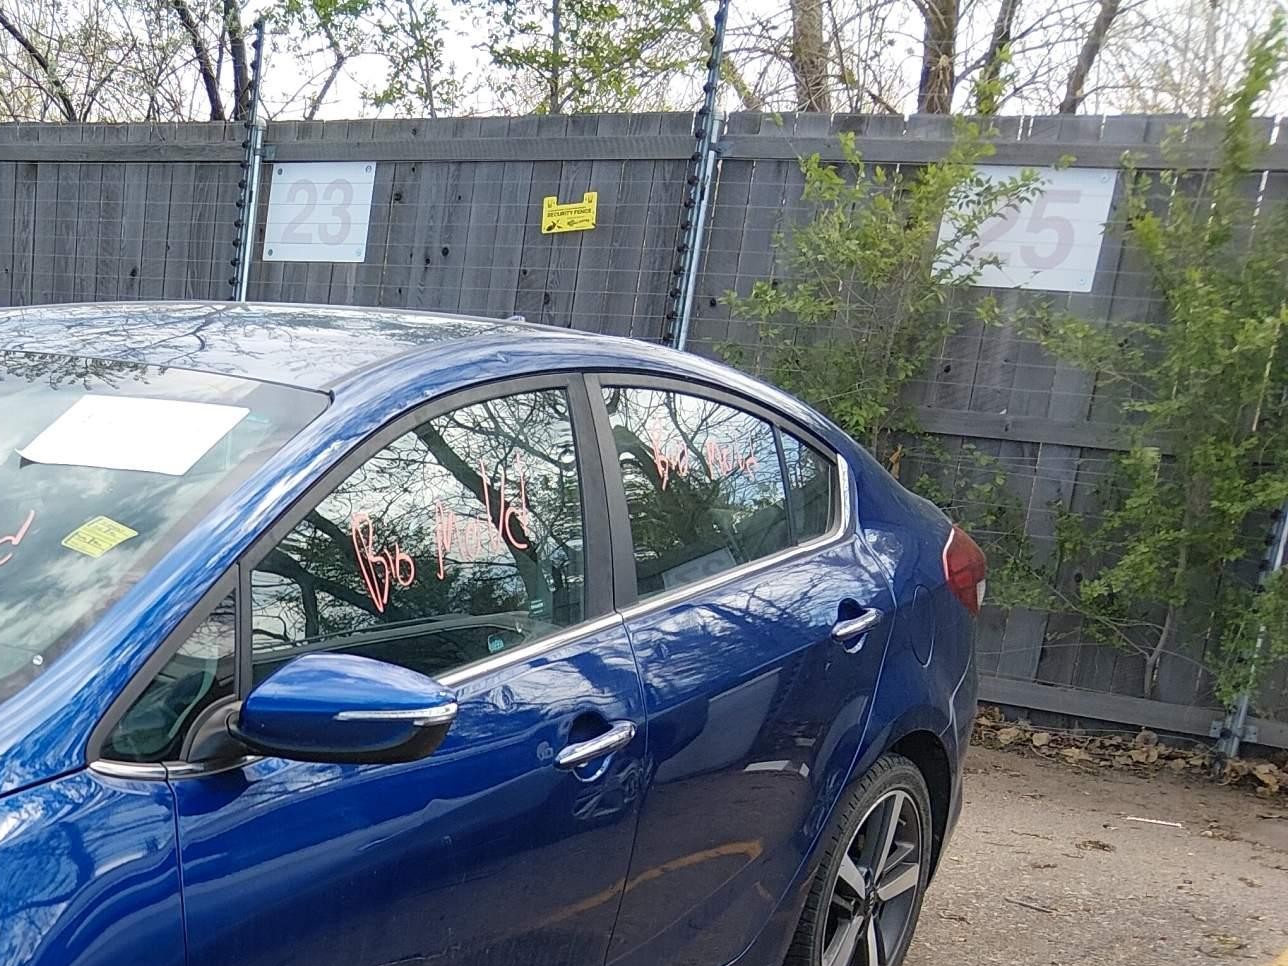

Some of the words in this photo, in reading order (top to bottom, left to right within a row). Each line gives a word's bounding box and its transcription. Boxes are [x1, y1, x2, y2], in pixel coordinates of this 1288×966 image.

[280, 178, 354, 247] 23
[546, 210, 573, 218] SECURITY
[573, 207, 592, 215] FENCE
[966, 189, 1082, 271] 25
